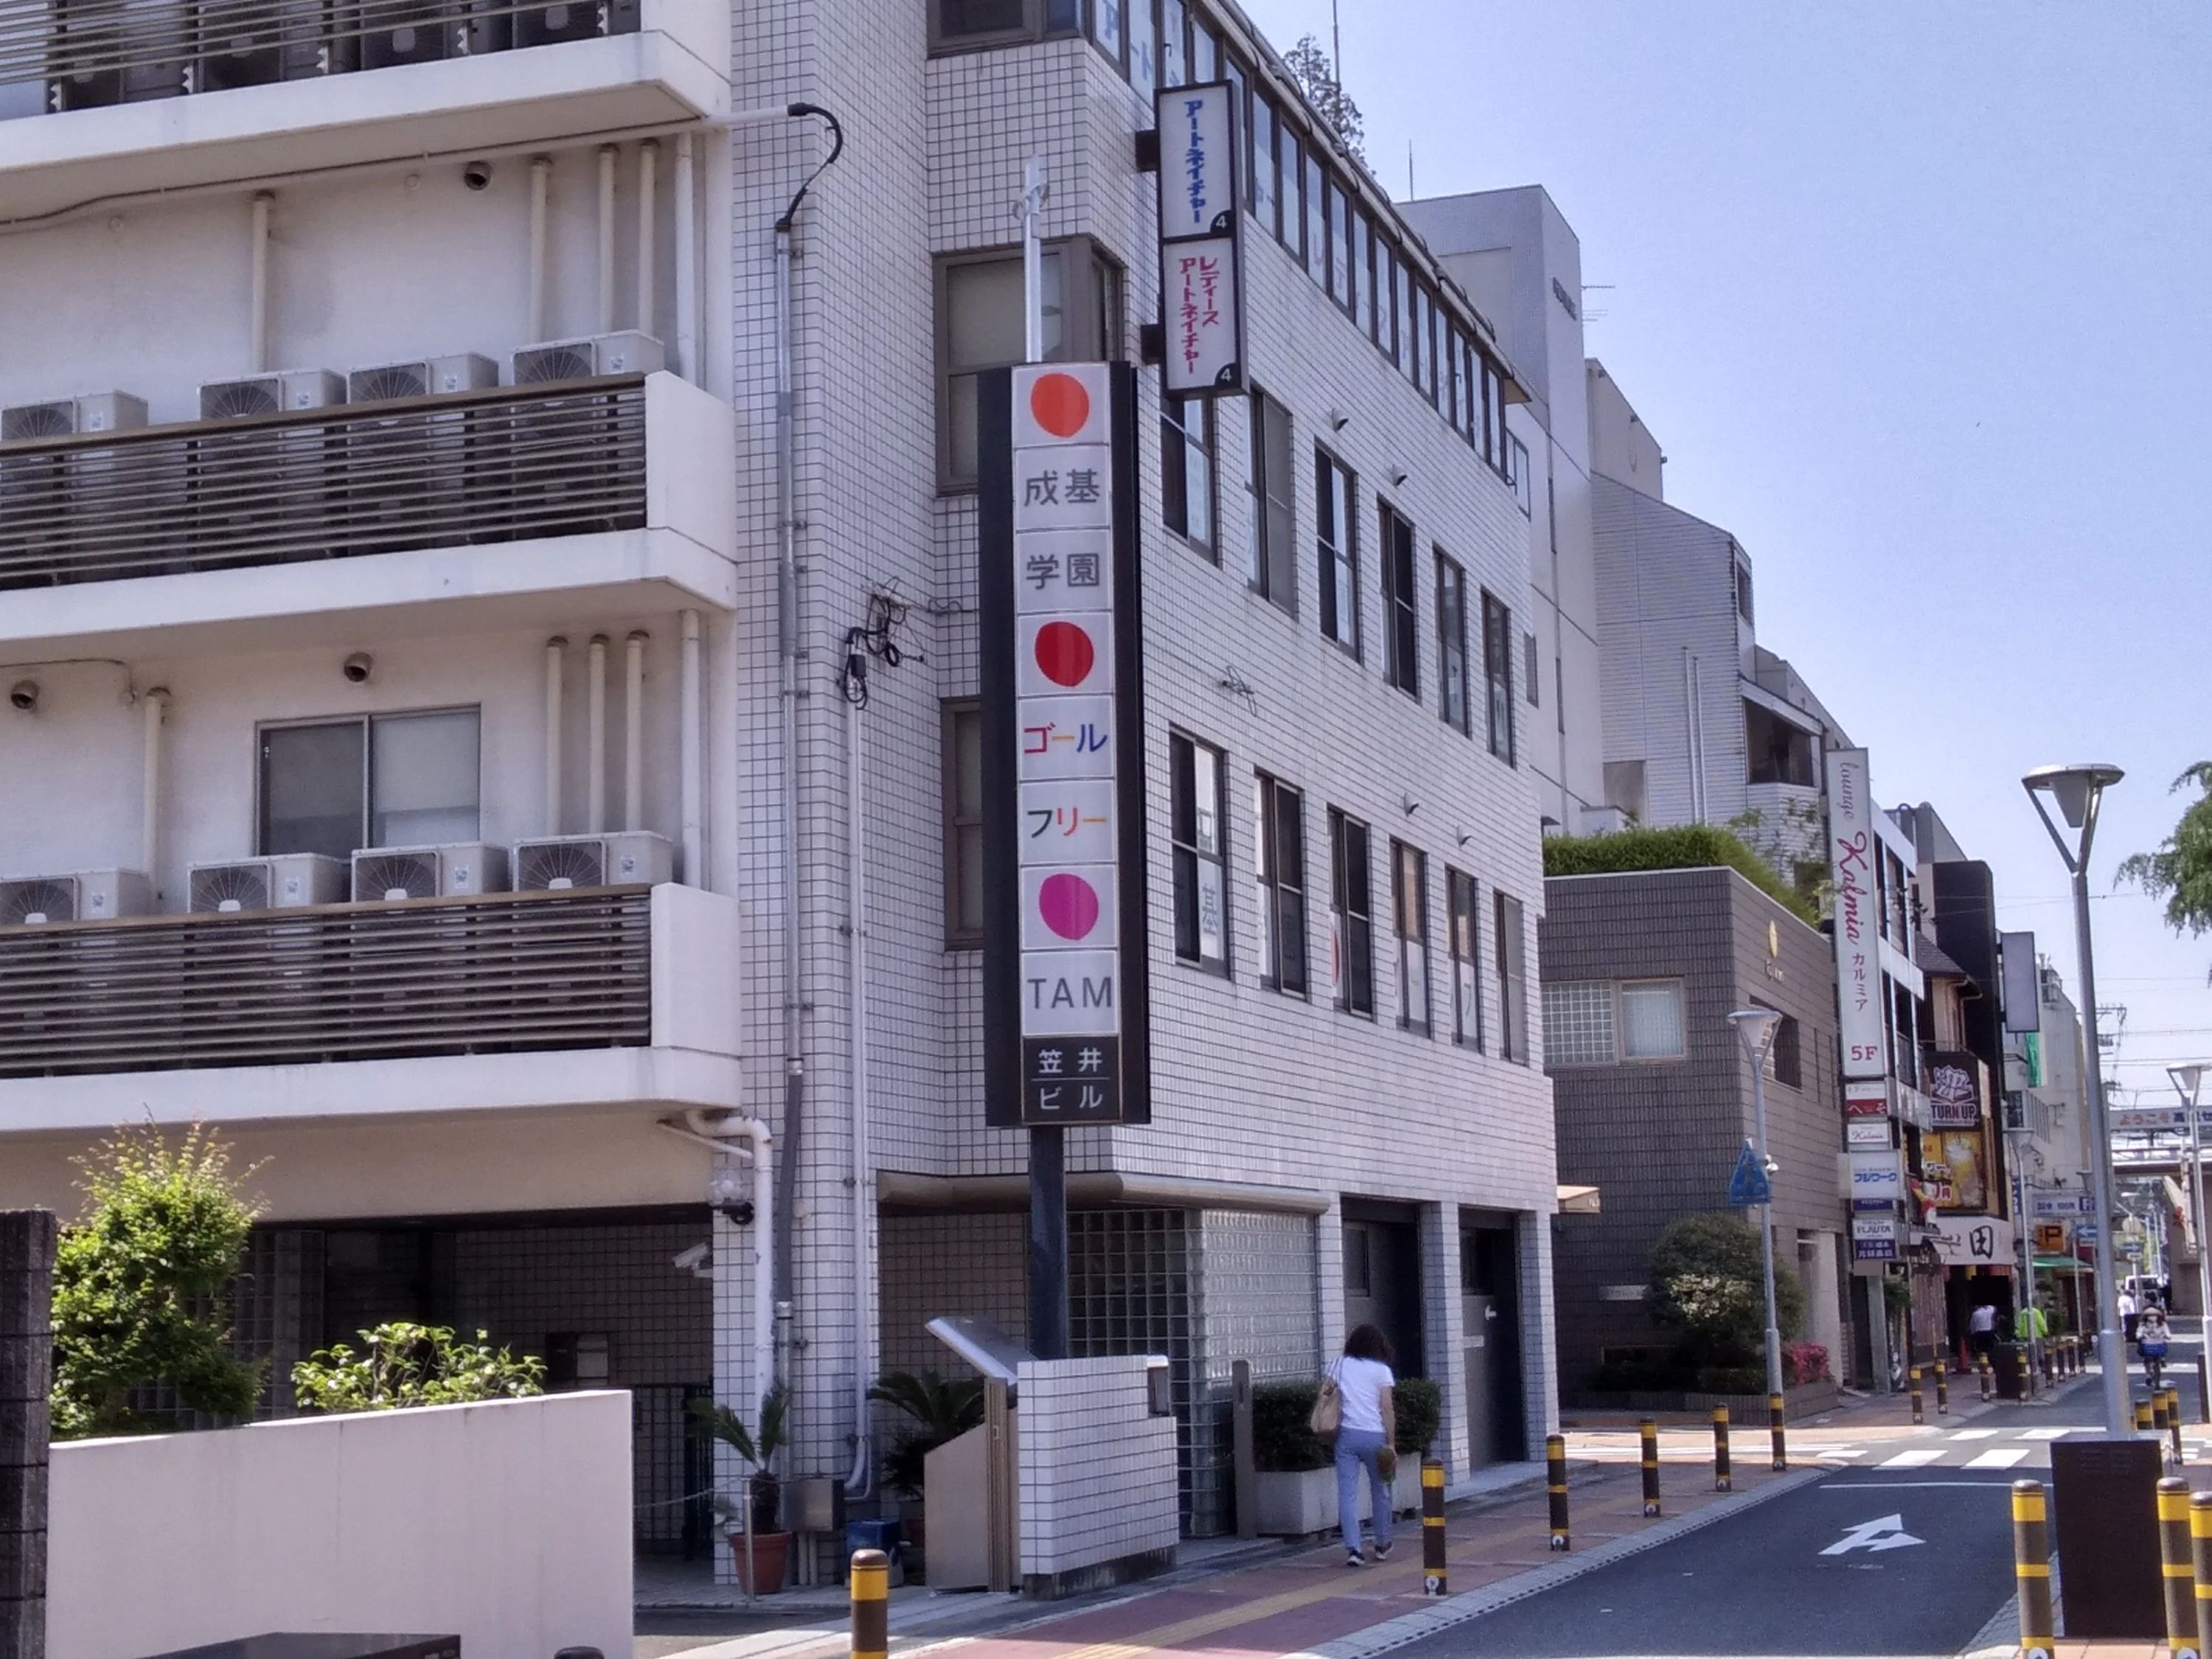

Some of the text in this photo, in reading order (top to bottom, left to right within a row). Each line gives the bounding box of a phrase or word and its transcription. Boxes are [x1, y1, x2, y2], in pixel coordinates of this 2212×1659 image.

[1184, 100, 1206, 223] アートネイチャー
[1215, 215, 1228, 229] 4
[1199, 256, 1220, 327] レディース
[1180, 257, 1199, 375] アートネイチャー
[1220, 368, 1233, 382] 4
[1024, 469, 1100, 507] 成基
[1026, 553, 1099, 590] 学園
[1024, 722, 1107, 754] ゴール
[1836, 762, 1860, 820] lounge
[1027, 807, 1107, 838] フリー
[1837, 830, 1868, 946] Kalmia
[1027, 977, 1112, 1009] TAM
[1852, 953, 1868, 1012] カルミア
[1037, 1048, 1102, 1074] 笠井
[1851, 1046, 1878, 1062] 5F
[1040, 1085, 1102, 1110] ビル
[1930, 1105, 1959, 1119] TURN
[1854, 1172, 1898, 1183] フジワーク
